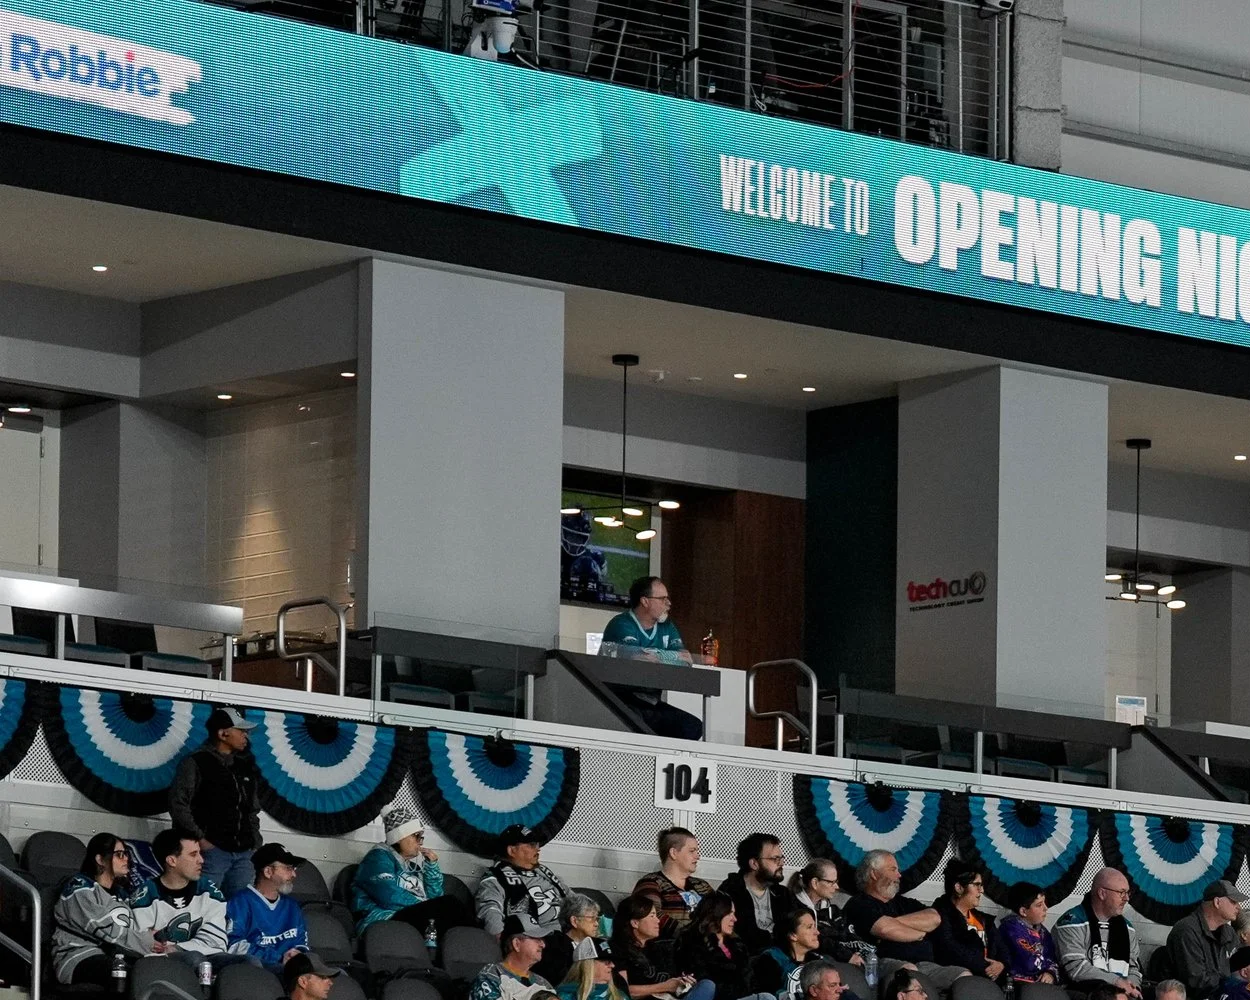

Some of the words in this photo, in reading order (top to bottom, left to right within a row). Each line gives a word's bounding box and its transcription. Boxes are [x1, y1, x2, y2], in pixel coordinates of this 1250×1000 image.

[10, 32, 160, 97] Robbie
[720, 153, 835, 231] WELCOME
[844, 178, 870, 236] TO
[893, 175, 1162, 308] OPENING
[662, 762, 712, 804] 104
